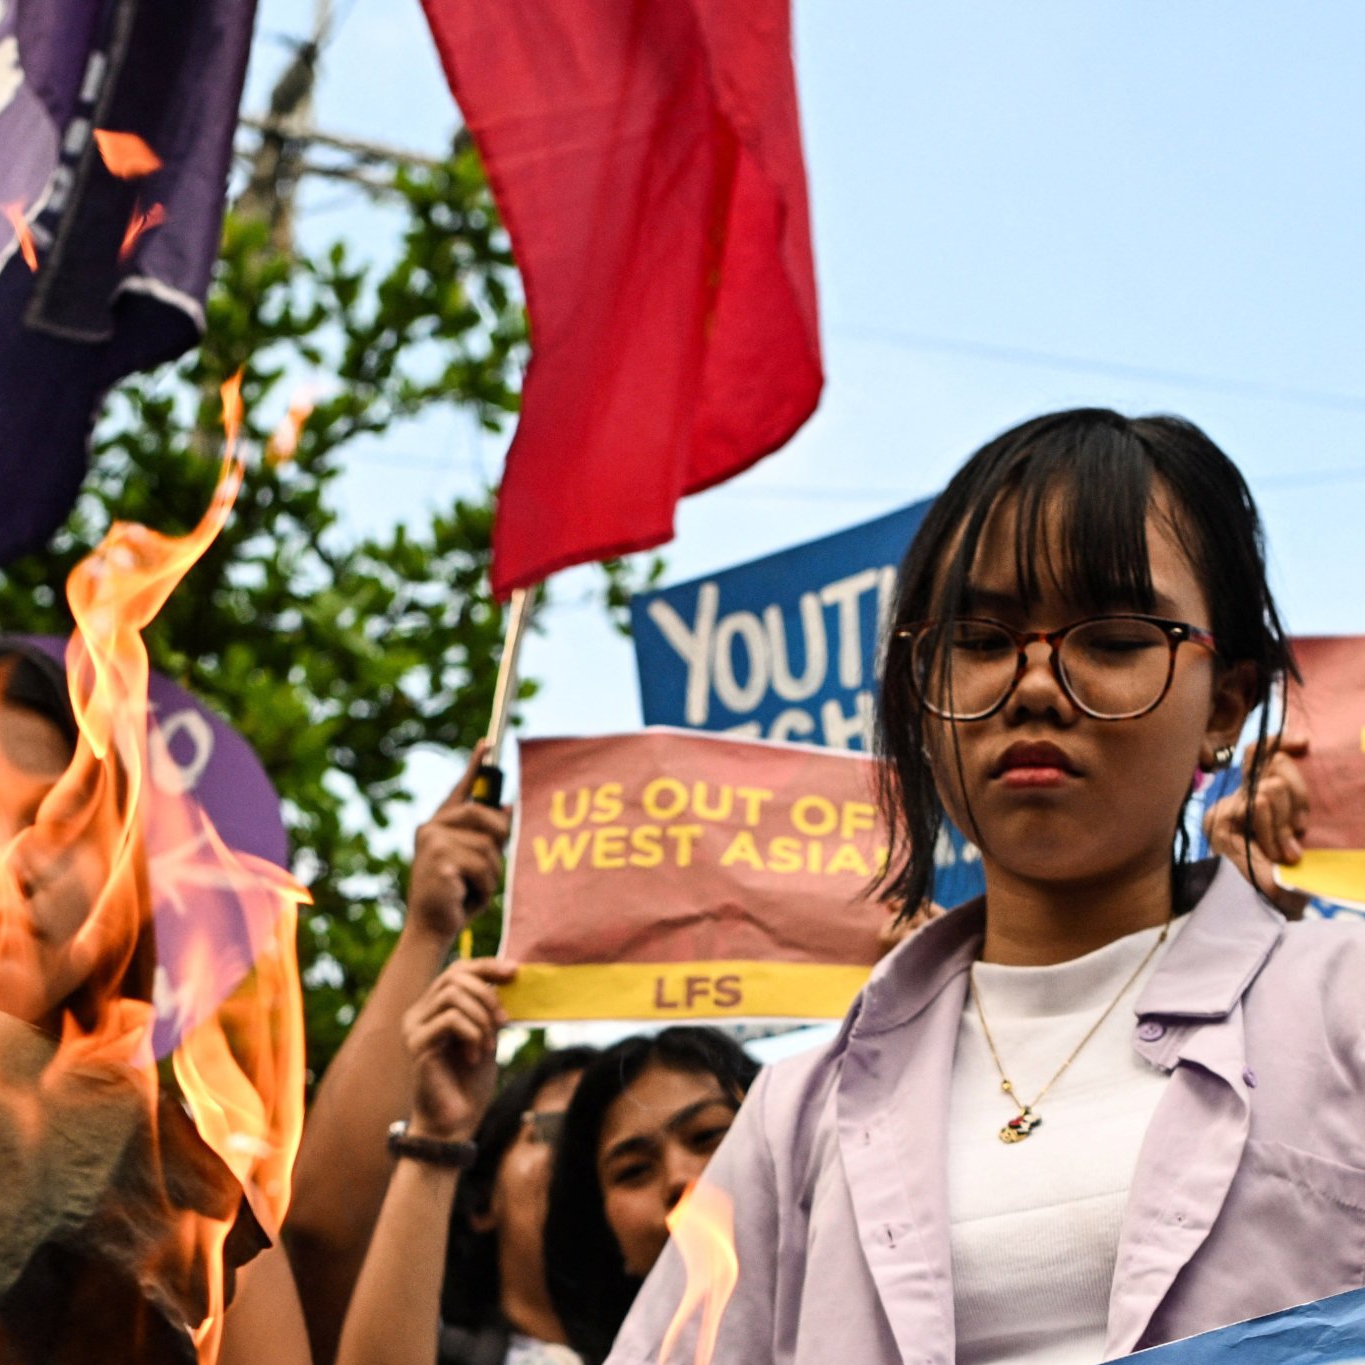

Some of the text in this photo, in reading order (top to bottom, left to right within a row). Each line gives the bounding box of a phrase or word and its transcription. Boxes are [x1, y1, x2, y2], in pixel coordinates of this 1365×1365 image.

[549, 776, 877, 840] US OUT OF
[533, 823, 704, 875] WEST
[654, 974, 743, 1010] LFS
